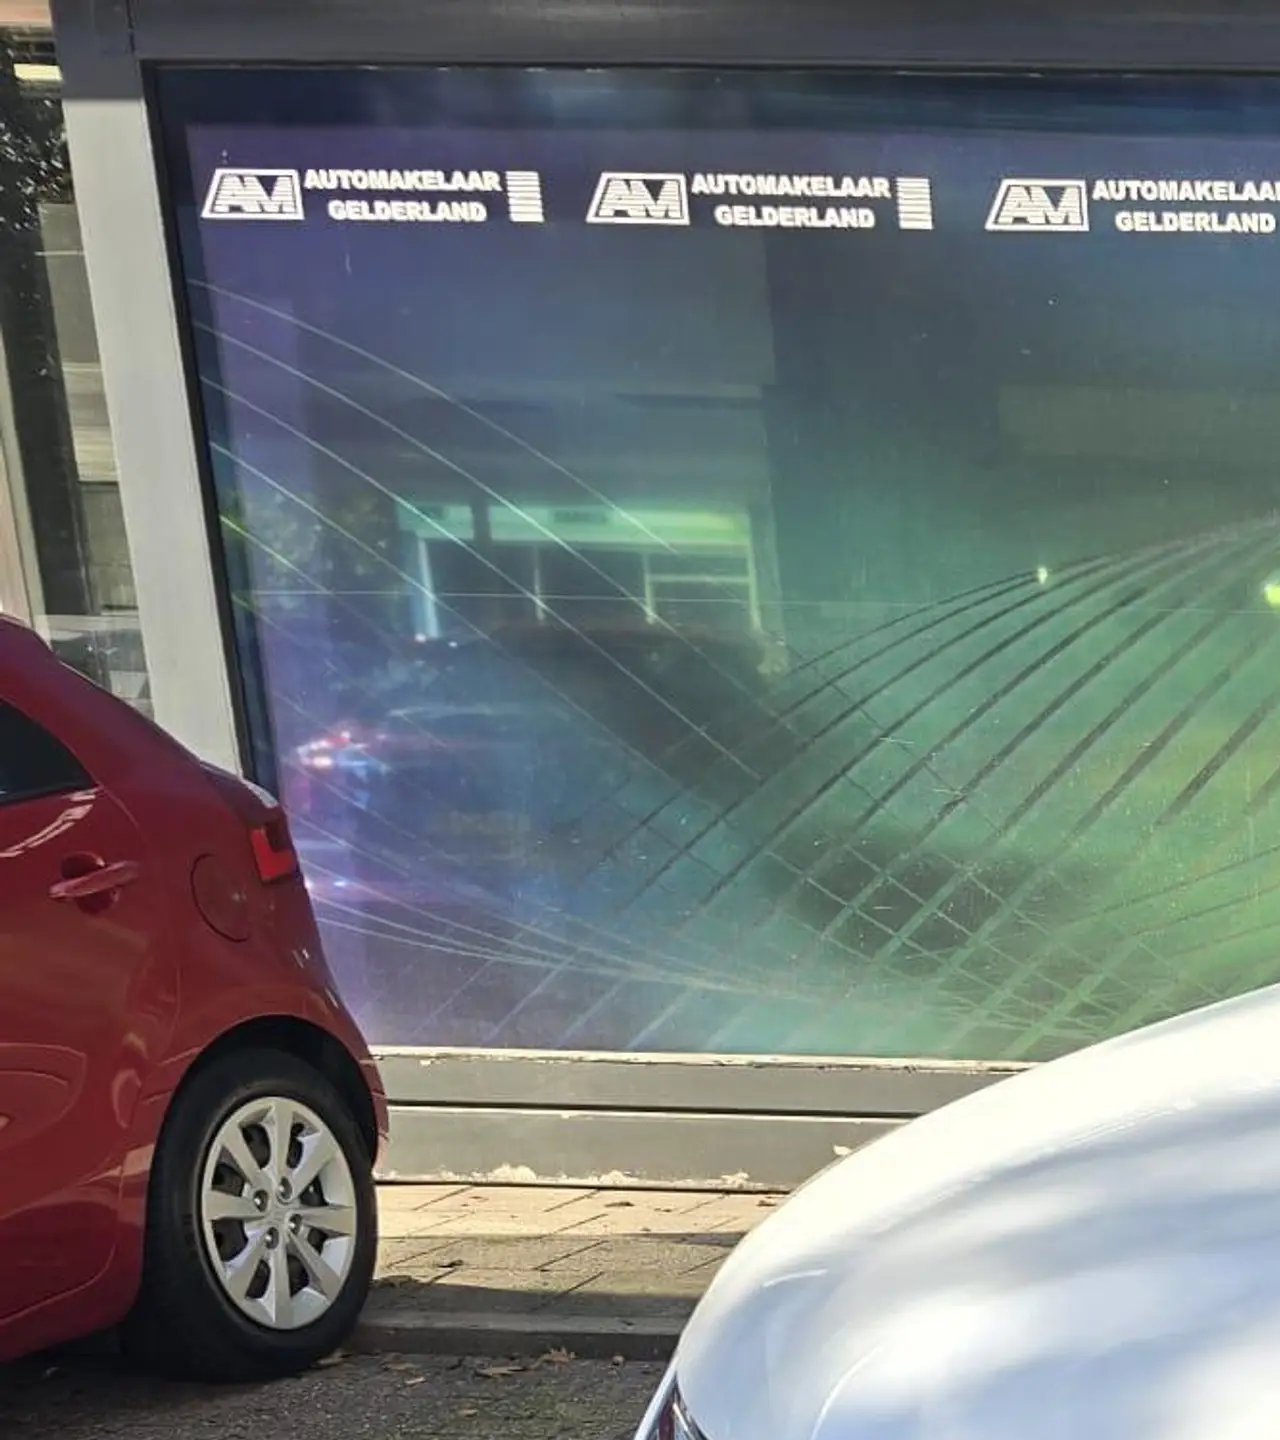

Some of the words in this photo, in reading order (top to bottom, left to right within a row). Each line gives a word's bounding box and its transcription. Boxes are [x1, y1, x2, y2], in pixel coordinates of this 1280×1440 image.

[303, 169, 502, 191] AUTOMAKELAAR
[691, 173, 892, 198] AUTOMAKELAAR
[213, 174, 296, 213] AM
[599, 178, 680, 217] AM
[997, 184, 1080, 225] AM
[327, 199, 487, 222] GELDERLAND
[714, 204, 875, 228] GELDERLAND
[1114, 211, 1276, 234] GELDERLAND
